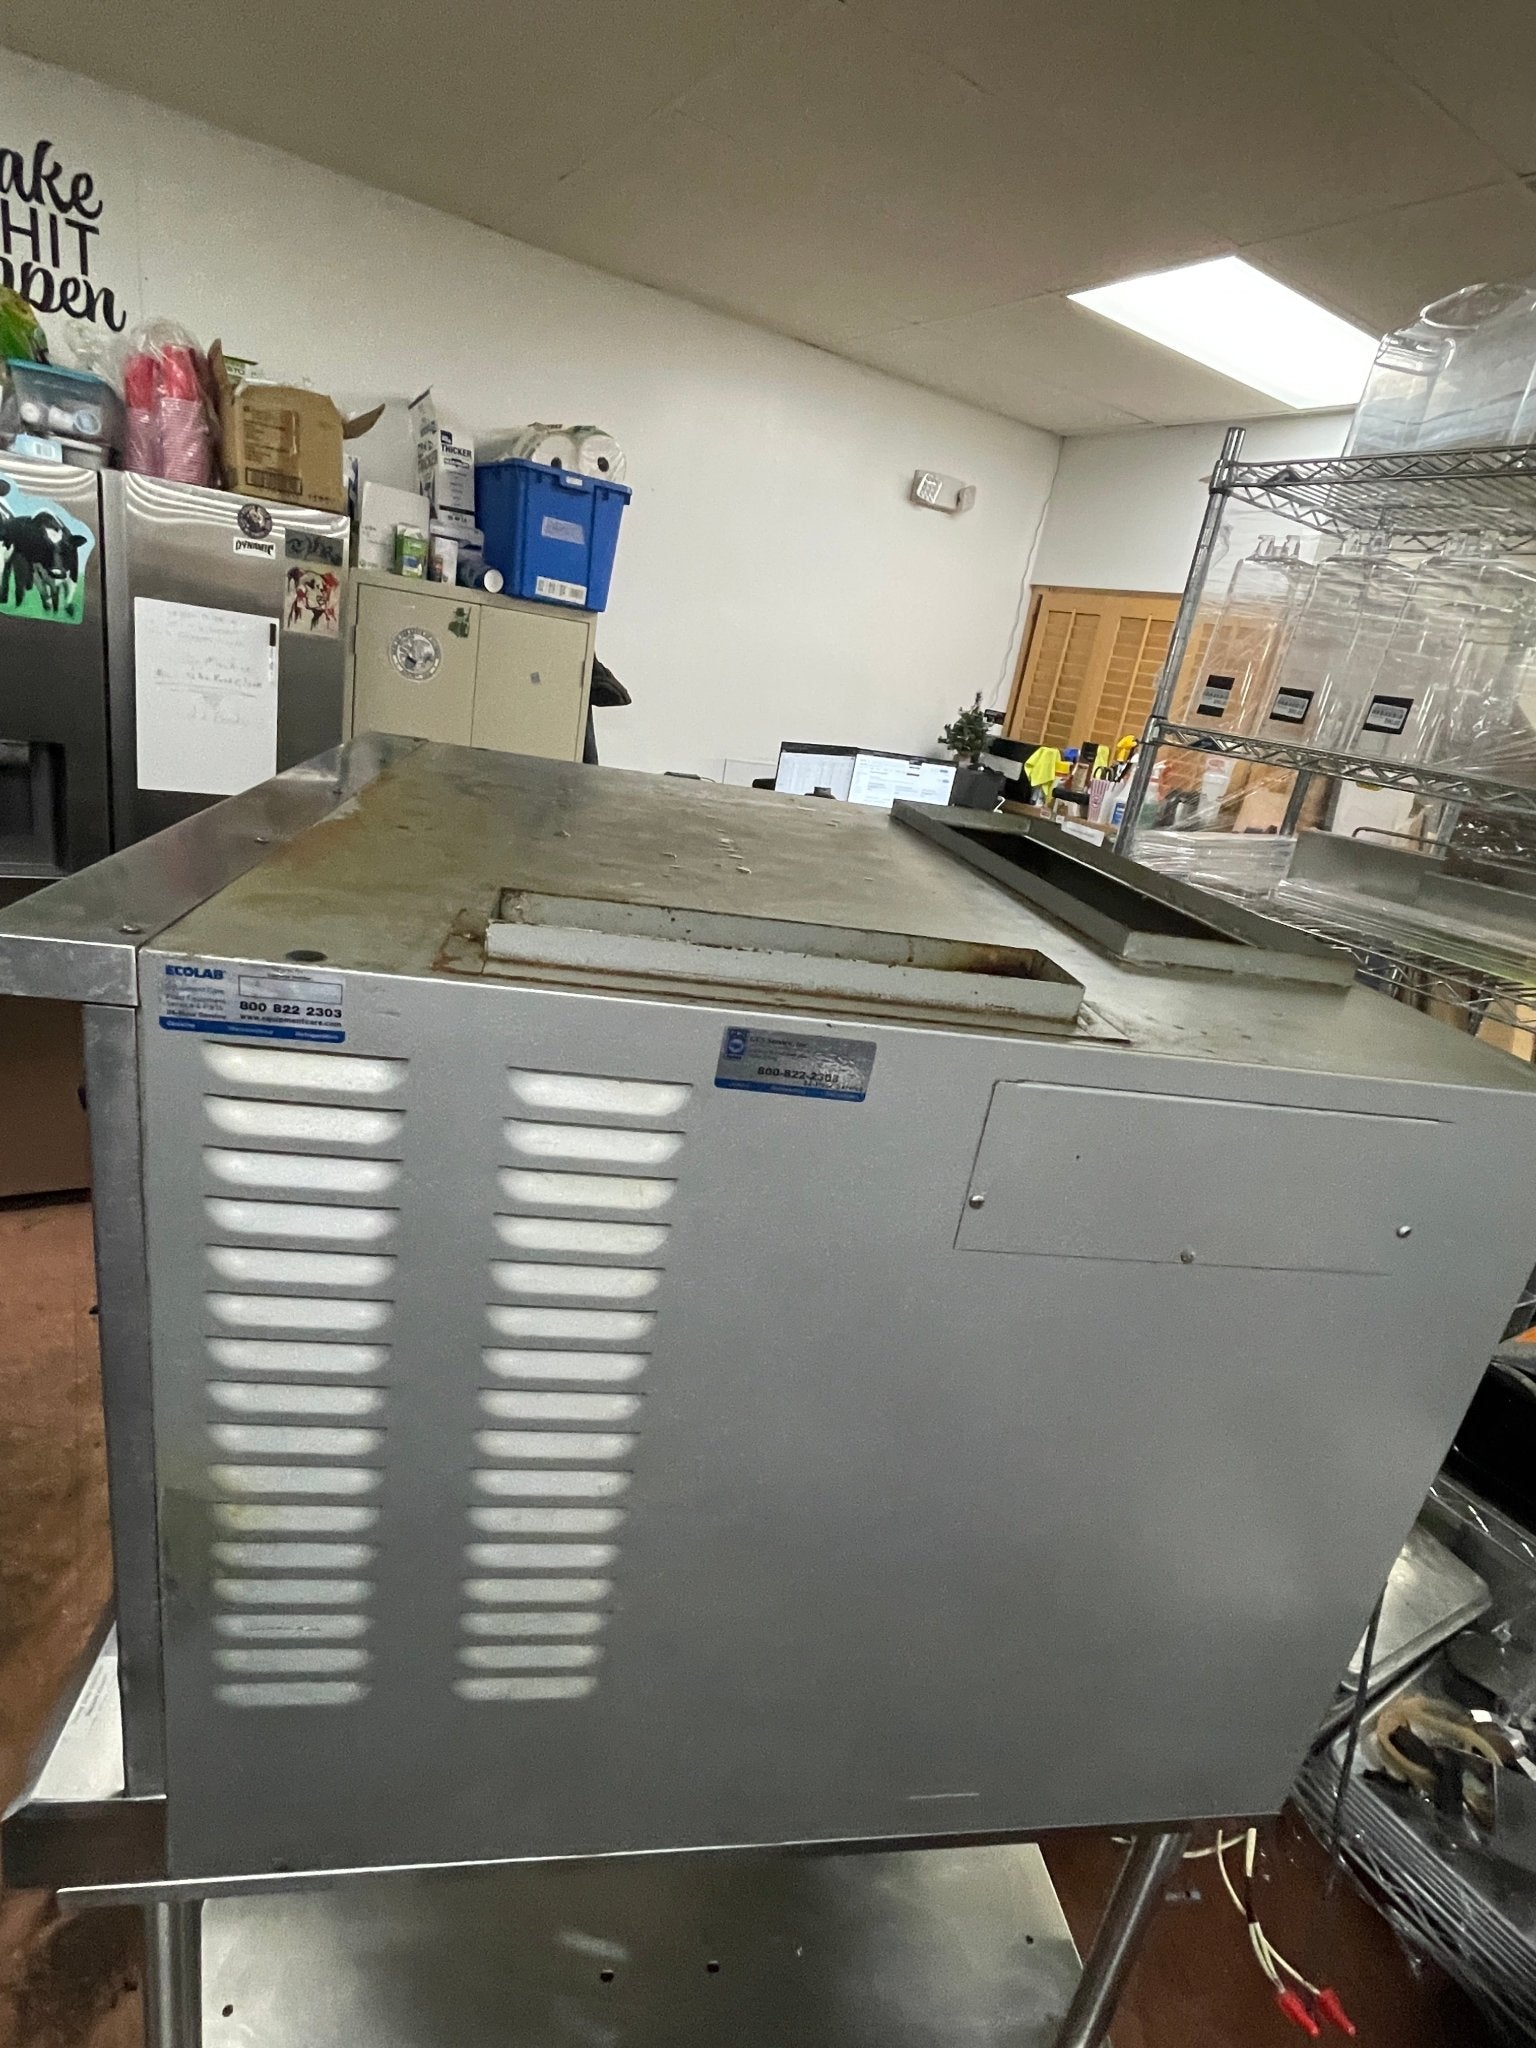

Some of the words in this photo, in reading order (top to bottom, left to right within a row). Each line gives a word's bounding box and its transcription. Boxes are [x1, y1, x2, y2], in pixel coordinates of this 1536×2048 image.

[0, 198, 100, 277] HIT
[441, 444, 472, 457] THICKER
[165, 965, 224, 980] ECOLAB
[239, 1001, 267, 1012] 800
[273, 1004, 300, 1015] 822
[306, 1007, 342, 1018] 2303
[757, 1066, 839, 1083] 800-822-2303
